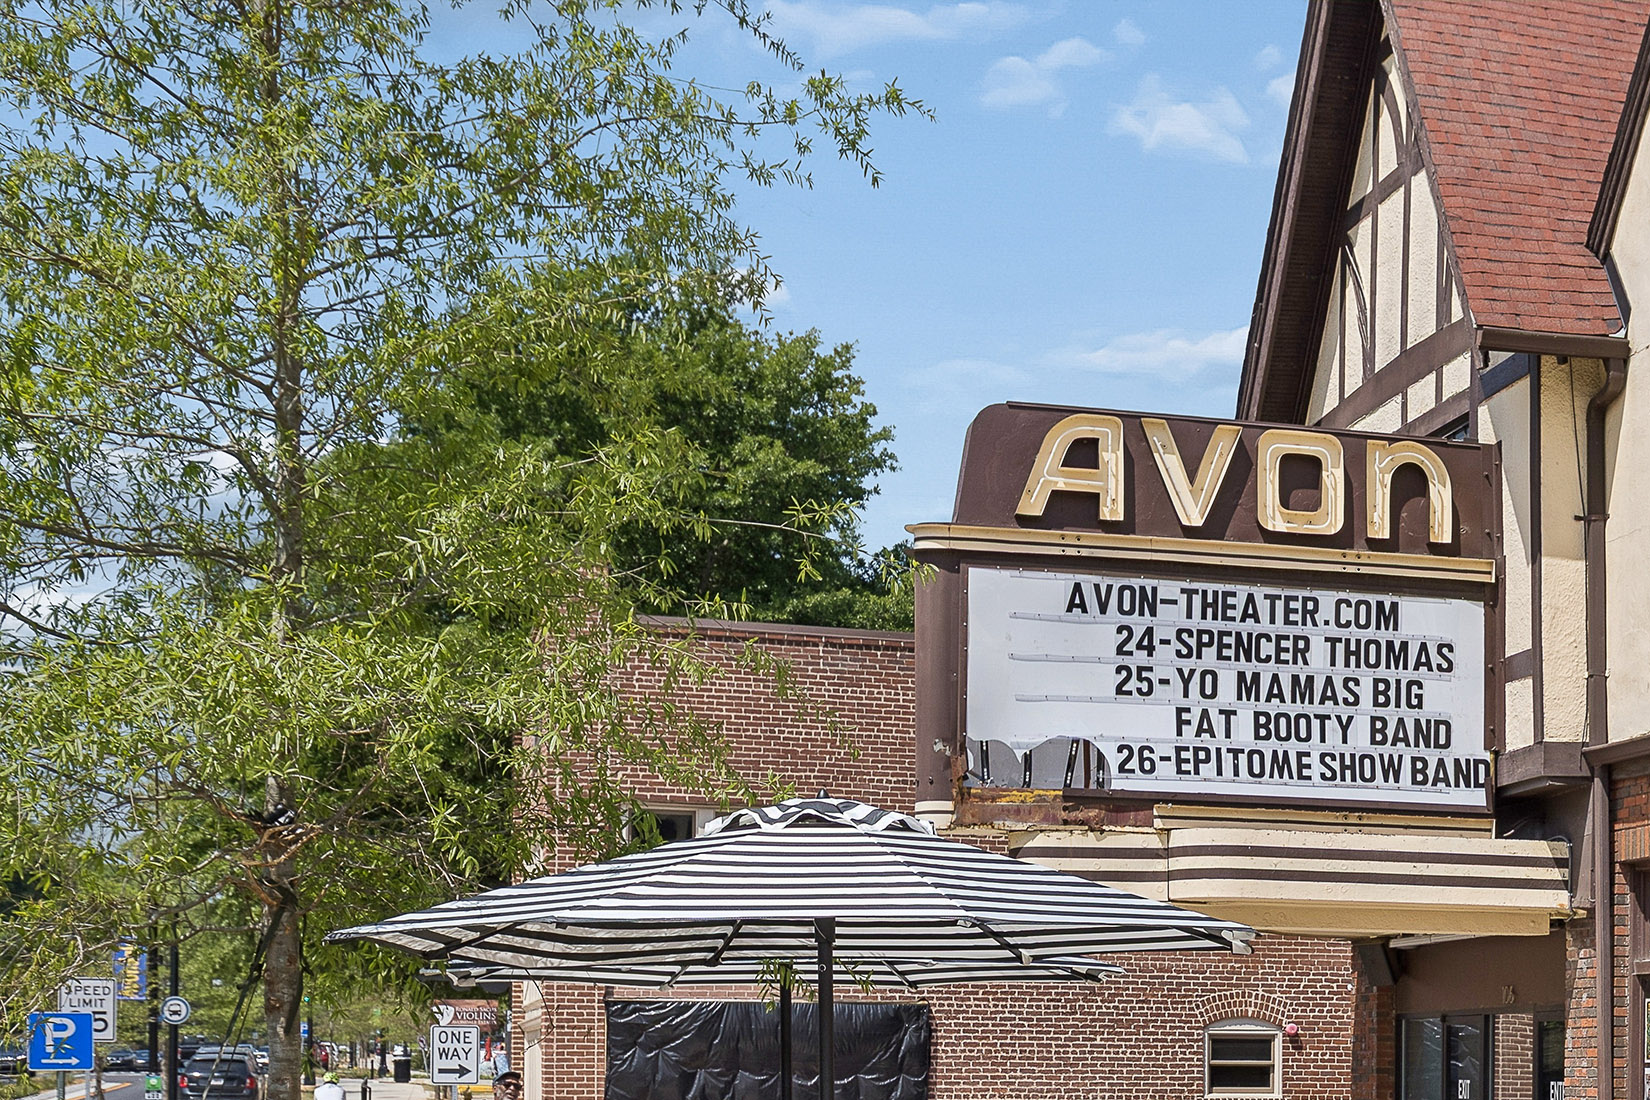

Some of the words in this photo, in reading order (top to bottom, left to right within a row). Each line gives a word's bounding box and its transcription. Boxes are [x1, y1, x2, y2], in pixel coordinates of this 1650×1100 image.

[1065, 582, 1400, 632] AVON-THEATER.COM
[1116, 624, 1310, 666] 24-SPENCER
[1326, 636, 1455, 673] THOMAS
[1115, 664, 1219, 700] 25-YO
[1236, 670, 1361, 709] MAMAS
[1373, 677, 1424, 710] BIG
[1176, 707, 1238, 739] FAT
[1254, 711, 1354, 746] BOOTY
[1370, 715, 1452, 750] BAND
[1117, 743, 1313, 780] 26-EPITOME
[1319, 752, 1404, 784] SHOW
[1410, 755, 1491, 789] BAND
[64, 985, 111, 996] SPEED
[69, 998, 105, 1008] LIMIT
[456, 1012, 496, 1020] VIOLINS
[45, 1017, 76, 1053] P
[438, 1031, 472, 1044] ONE
[438, 1047, 472, 1060] WAY
[1458, 1080, 1470, 1099] EXIT
